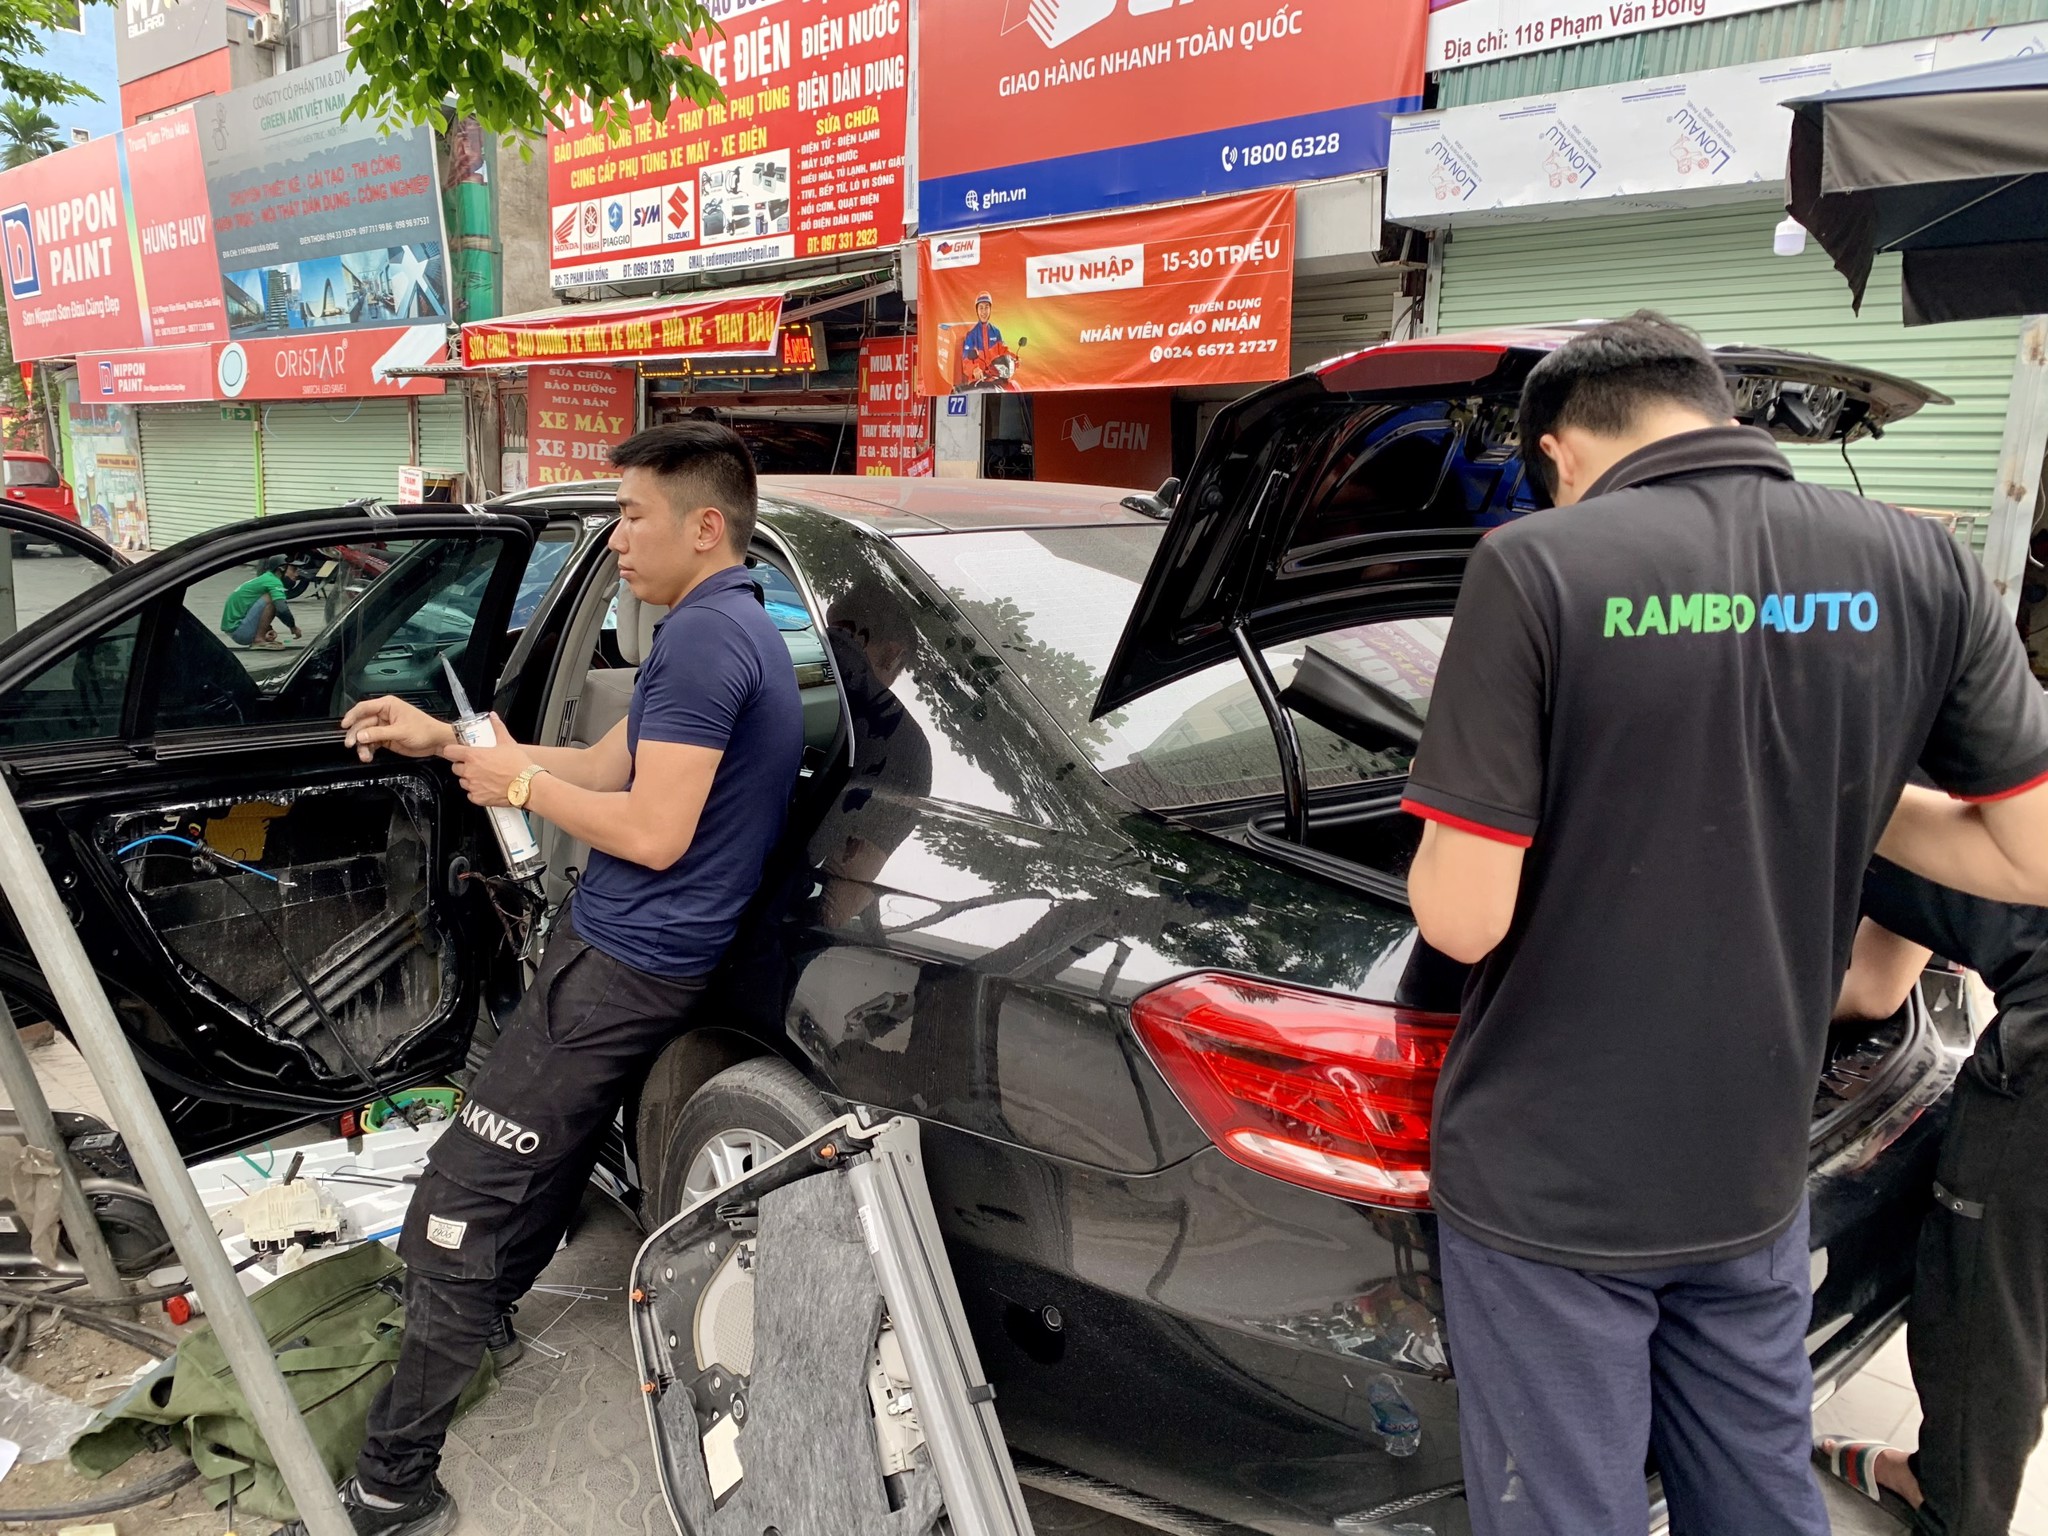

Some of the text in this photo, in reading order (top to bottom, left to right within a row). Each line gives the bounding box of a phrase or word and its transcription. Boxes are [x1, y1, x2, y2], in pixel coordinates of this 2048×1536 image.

[802, 0, 900, 61] ĐIỆN NƯỚC
[1444, 40, 1472, 62] Địa
[1477, 28, 1508, 54] chỉ:
[1514, 21, 1544, 46] 118
[1550, 16, 1602, 39] Phạm
[1610, 2, 1646, 26] Văn
[734, 16, 790, 86] ĐIỆN
[999, 4, 1304, 97] GIAO HÀNG NHANH TOÀN QUỐC
[798, 54, 904, 116] ĐIỆN DÂN DỤNG
[260, 93, 347, 131] GREEN ANT VIỆT NAM
[816, 105, 880, 136] SỬA CHỮA
[554, 138, 572, 164] BẢO
[574, 133, 604, 158] DƯỠNG
[634, 113, 652, 144] THỂ
[678, 108, 704, 134] THAY
[731, 95, 754, 122] PHỤ
[757, 86, 790, 114] TÙNG
[801, 128, 880, 155] ĐIỆN TỬ ĐIỆN LẠNH
[1241, 132, 1340, 167] 1800 6328
[570, 124, 768, 190] CUNG CẤP PHỤ TÙNG XE MÁY XE ĐIỆN
[801, 148, 858, 170] MÁY LỌC NƯỚC
[801, 192, 880, 216] NỒI CƠM, QUẠT ĐIỆN
[982, 186, 1026, 208] ghn.vn
[36, 187, 118, 245] NIPPON
[633, 204, 660, 227] SYM
[801, 210, 874, 230] ĐỒ ĐIỆN DÂN DỤNG
[142, 214, 207, 255] HÙNG HUY
[602, 234, 630, 248] PIAGGIO
[668, 230, 690, 240] SUZUKI
[807, 228, 878, 254] ĐT: 097 331 2923
[954, 240, 974, 252] GHN
[554, 242, 579, 252] HONDA
[583, 241, 600, 252] YAMAHA
[50, 237, 112, 286] PAINT
[623, 258, 674, 278] ĐT: 0969 126 329
[1037, 238, 1280, 285] THU NHẬP 15-30 TRIỆU
[1227, 297, 1262, 312] DỤNG
[469, 328, 486, 360] SỬA
[486, 330, 509, 358] CHỮA
[516, 324, 534, 357] BẢO
[536, 325, 568, 355] DƯỠNG
[570, 330, 582, 353] XE
[584, 320, 608, 355] MÁY,
[611, 323, 624, 351] XE
[626, 317, 652, 355] ĐIỆN
[662, 310, 684, 347] RỬA
[689, 317, 704, 346] XE
[714, 312, 744, 344] THAY
[1080, 312, 1261, 344] NHÂN VIÊN GIAO NHẬN
[1163, 339, 1278, 359] 024 6672 2727
[114, 362, 146, 378] NIPPON
[548, 366, 612, 380] SỬA CHỮA
[870, 354, 892, 372] MUA
[118, 378, 144, 392] PAINT
[544, 380, 618, 394] BẢO DƯỠNG
[870, 380, 892, 401] MÁY
[552, 396, 609, 408] MUA BÁN
[950, 398, 965, 413] 77
[538, 410, 624, 434] XE MÁY
[1102, 420, 1150, 450] GHN
[536, 439, 614, 466] XE ĐIỆ
[859, 446, 866, 456] XE
[868, 446, 876, 458] GA
[880, 446, 888, 458] XE
[890, 442, 898, 458] SỐ
[902, 446, 910, 458] XE
[539, 462, 584, 483] RỬA
